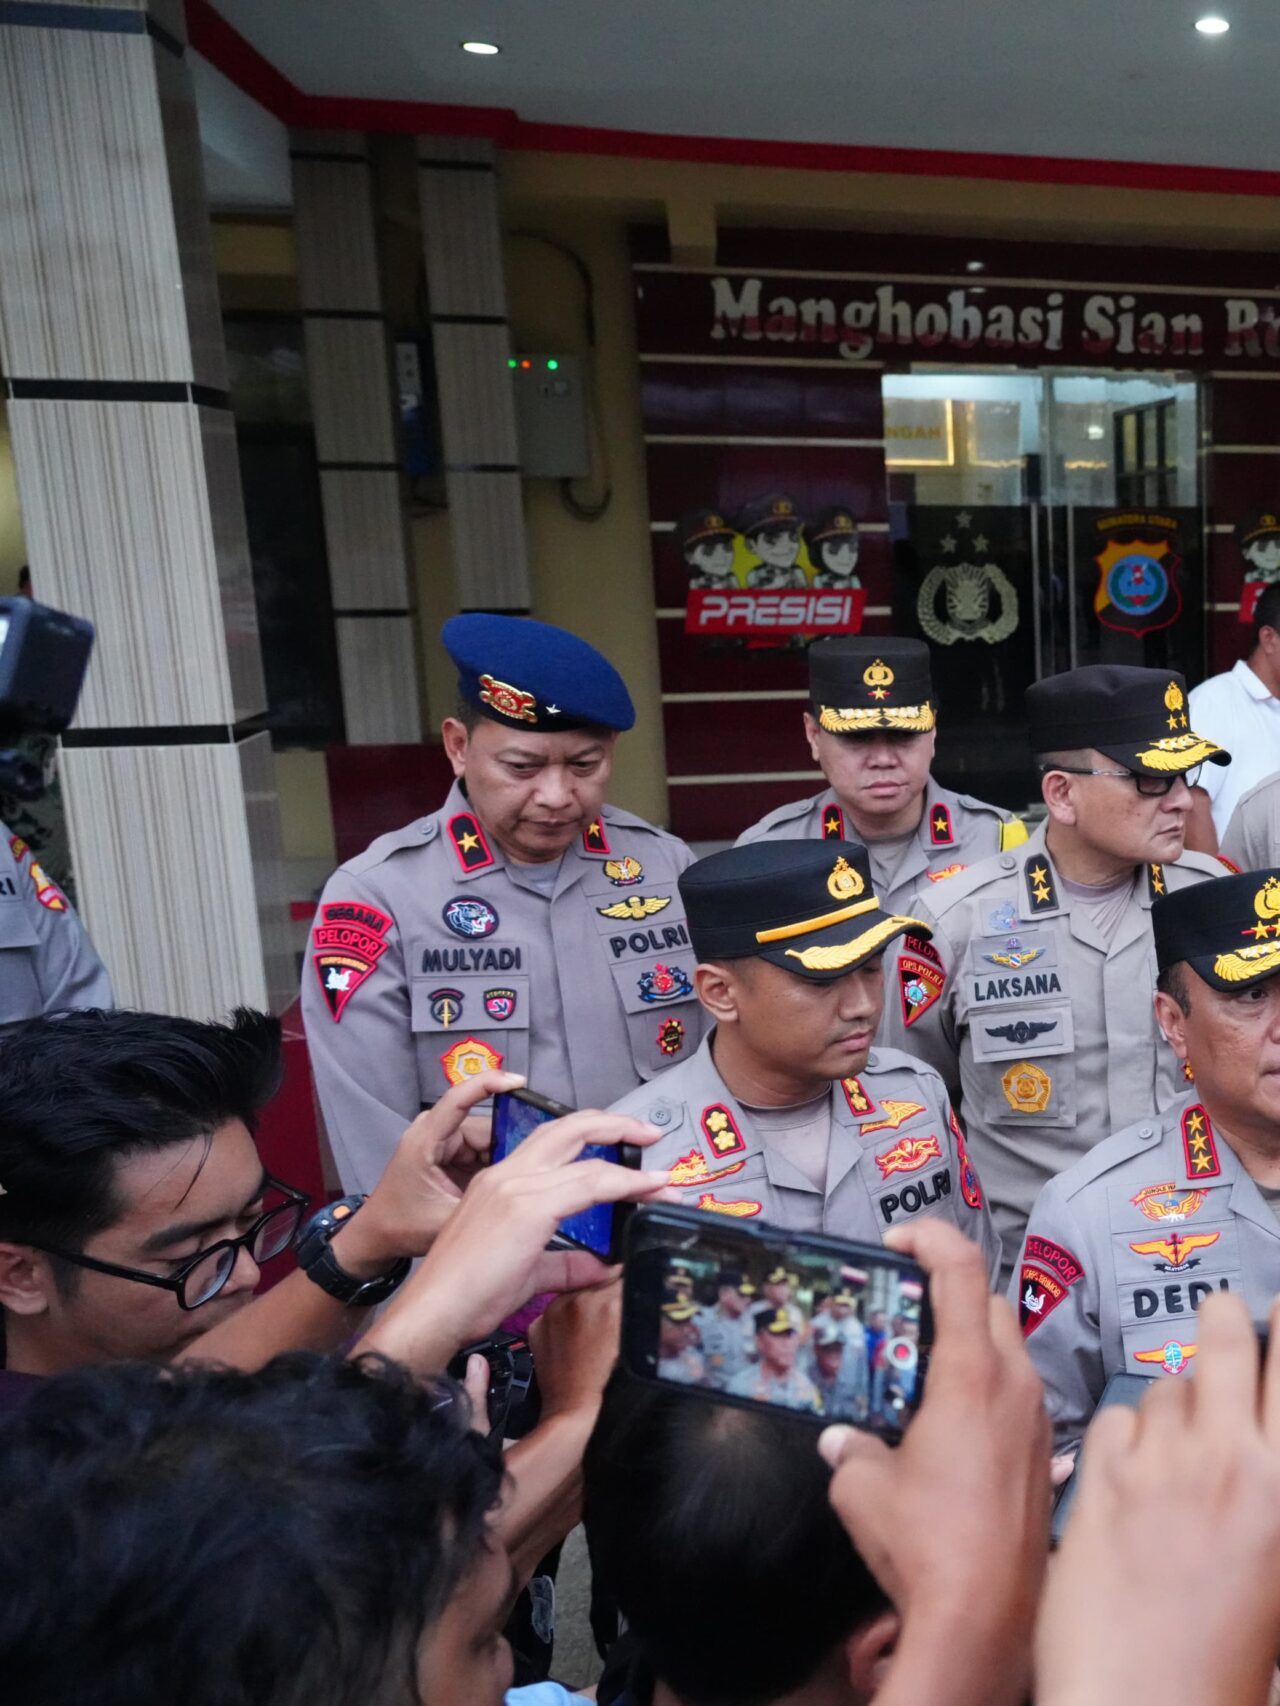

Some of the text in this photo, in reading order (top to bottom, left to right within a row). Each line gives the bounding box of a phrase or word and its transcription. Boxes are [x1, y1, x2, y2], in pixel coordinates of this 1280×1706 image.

[711, 277, 1063, 360] Manghobasi
[1082, 294, 1204, 354] Sian
[699, 595, 852, 626] PRESISI
[318, 929, 379, 955] PELOPOR
[609, 924, 689, 958] POLRI
[422, 947, 522, 973] MULYADI
[974, 973, 1062, 1001] LAKSANA
[879, 1168, 952, 1224] POLRI
[1028, 1240, 1078, 1279] PELOPOR
